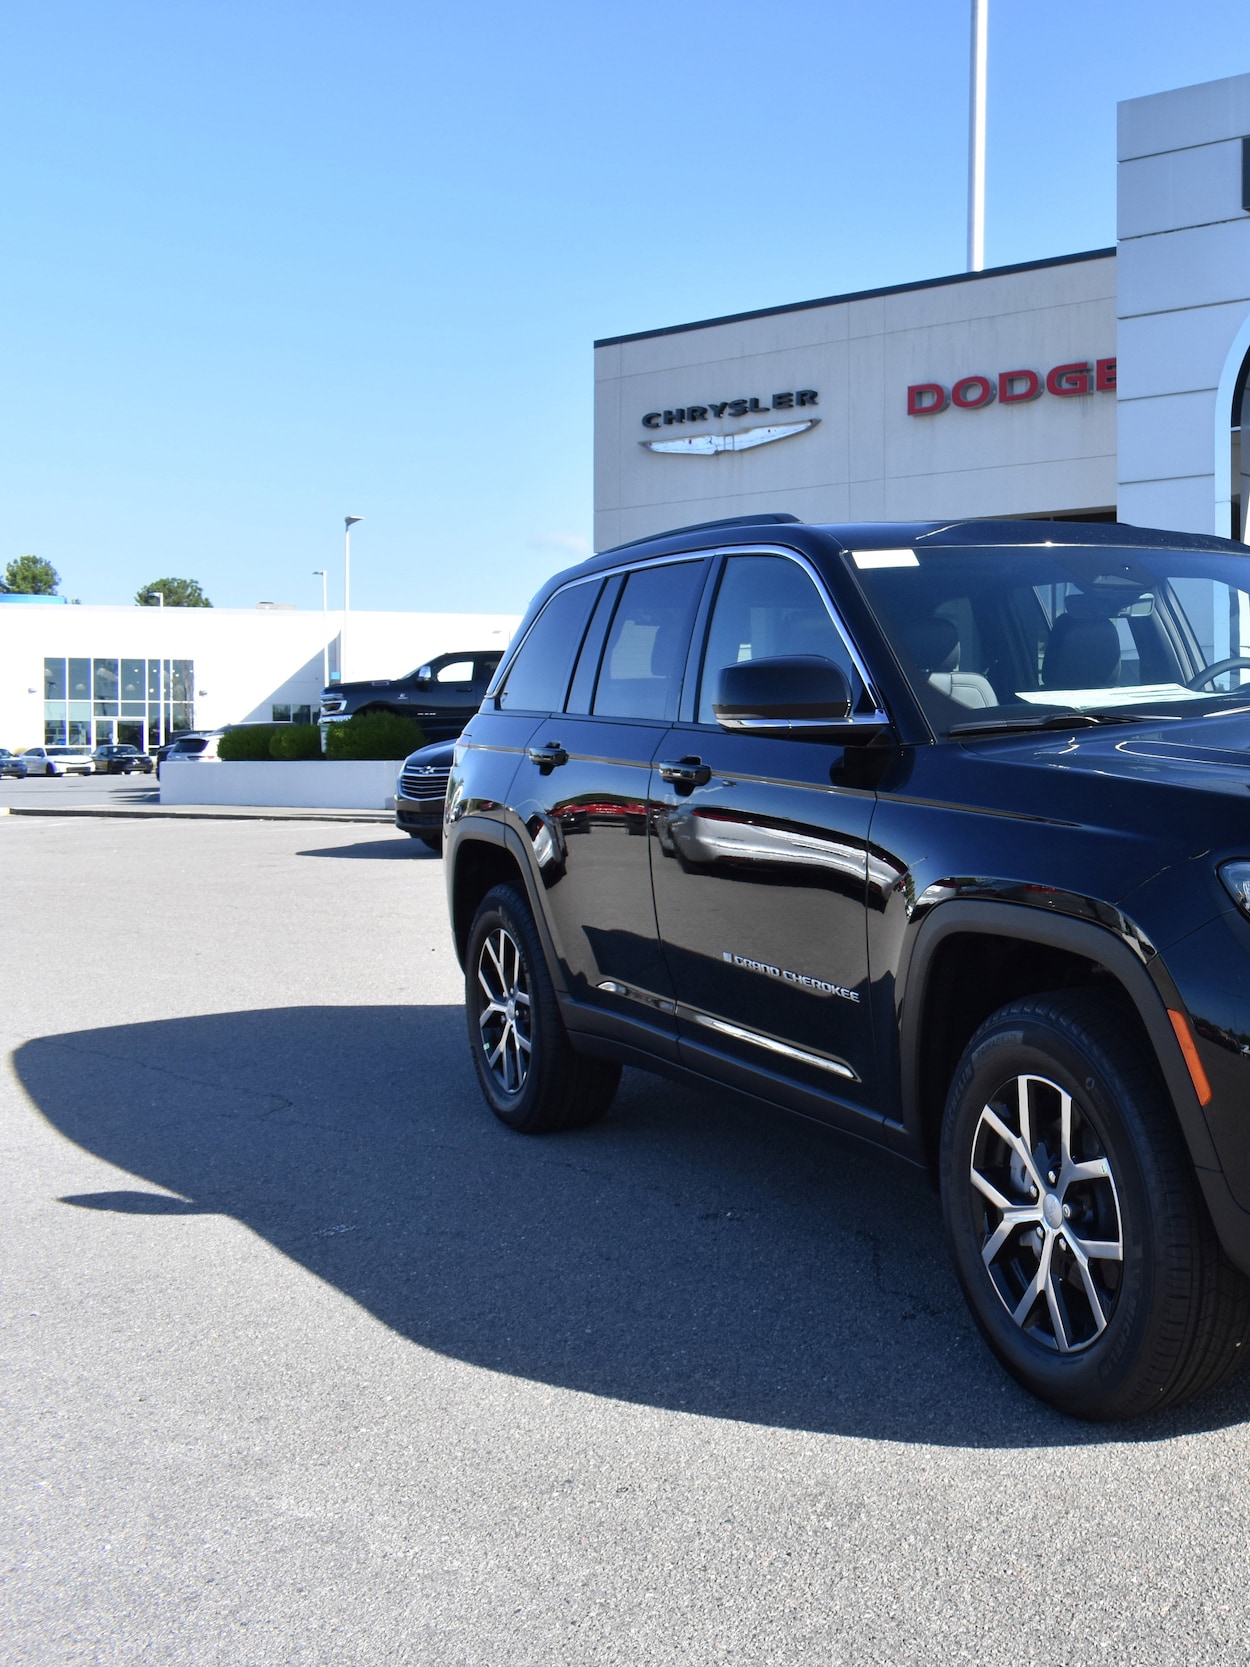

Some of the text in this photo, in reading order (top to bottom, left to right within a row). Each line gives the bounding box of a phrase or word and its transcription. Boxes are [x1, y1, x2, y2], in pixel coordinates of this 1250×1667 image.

[642, 389, 819, 429] CHRYSLER
[907, 357, 1117, 417] DODGE
[734, 955, 860, 1003] GRAND CHEROKEE
